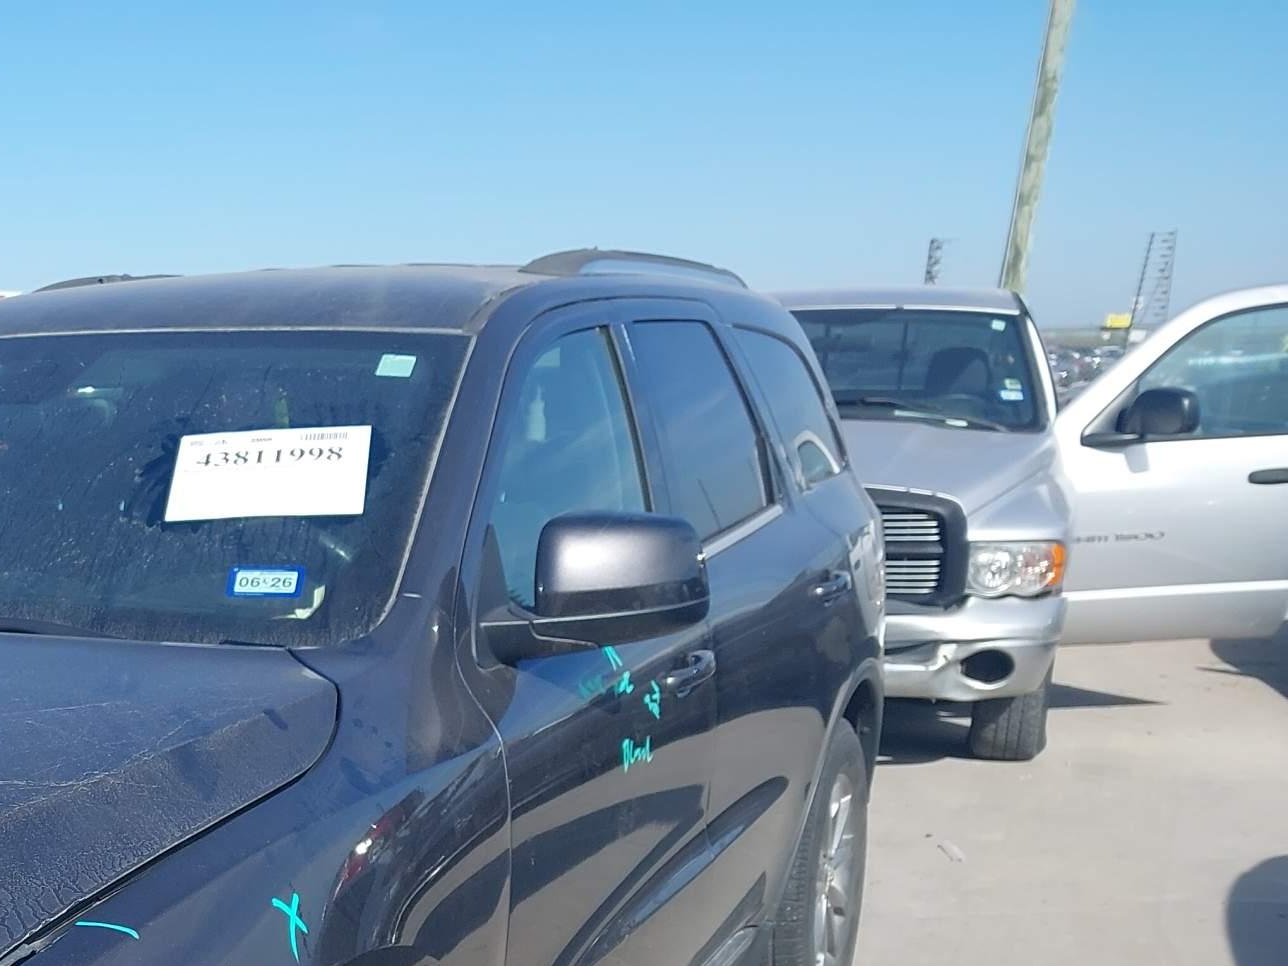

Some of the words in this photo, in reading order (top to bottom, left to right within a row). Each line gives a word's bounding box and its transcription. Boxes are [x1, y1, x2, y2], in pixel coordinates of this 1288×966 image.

[197, 446, 343, 467] 43811998
[238, 576, 261, 589] 06
[270, 576, 293, 589] 26
